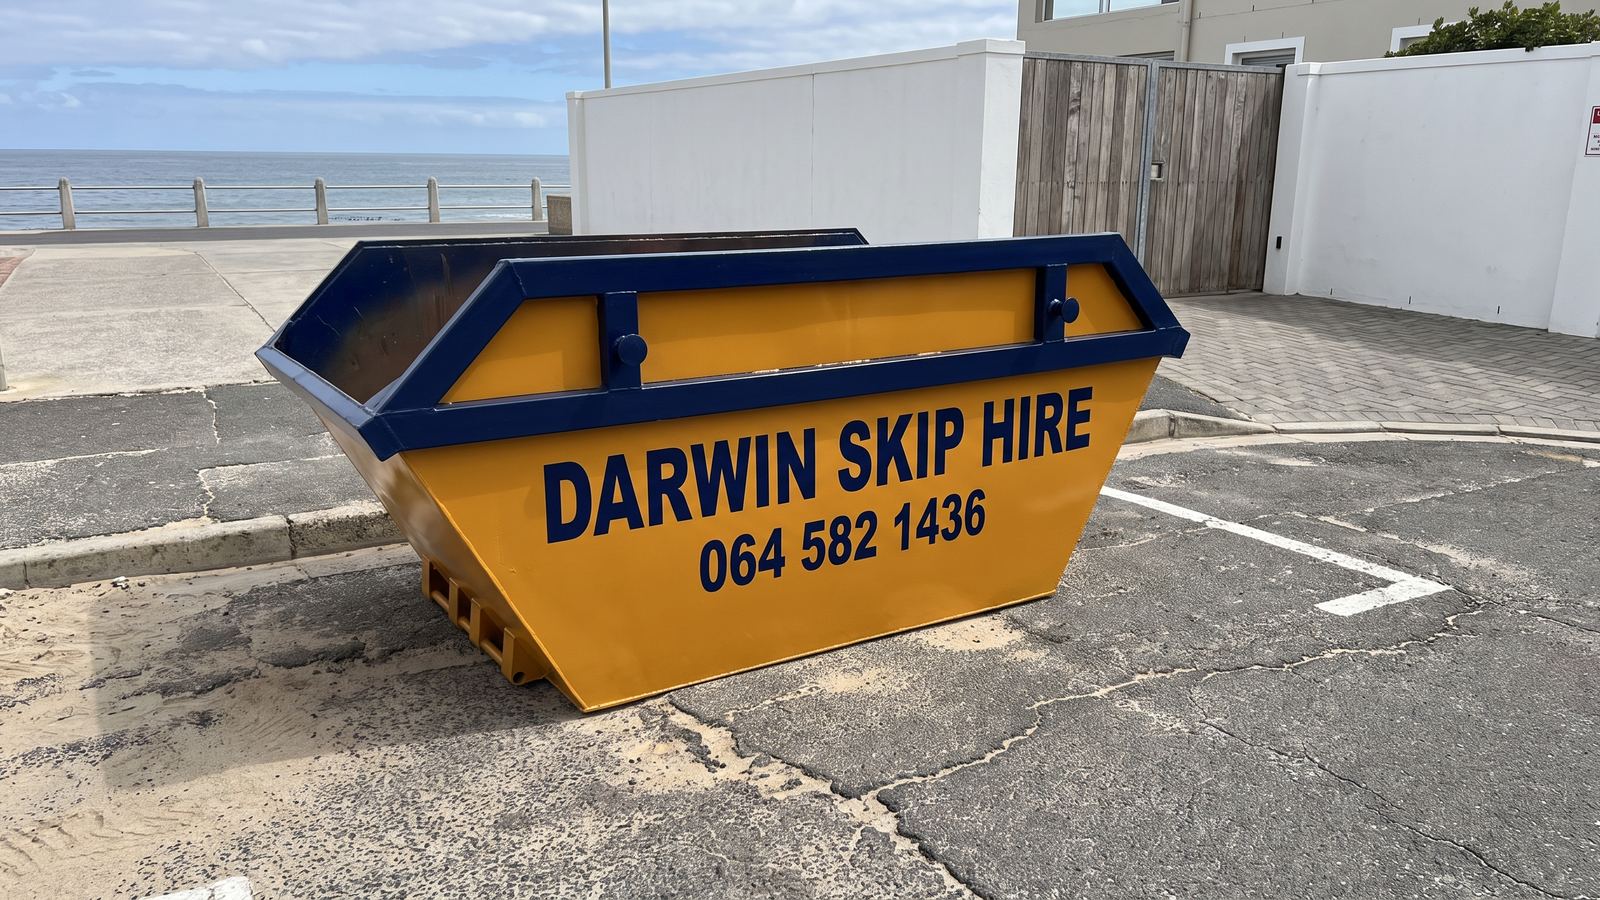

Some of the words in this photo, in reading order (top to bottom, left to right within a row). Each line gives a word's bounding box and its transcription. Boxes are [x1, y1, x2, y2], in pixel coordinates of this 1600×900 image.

[543, 427, 816, 545] DARWIN
[837, 406, 965, 493] SKIP
[981, 385, 1094, 468] HIRE
[699, 527, 786, 593] 064
[800, 510, 878, 572] 582
[894, 488, 986, 551] 1436
